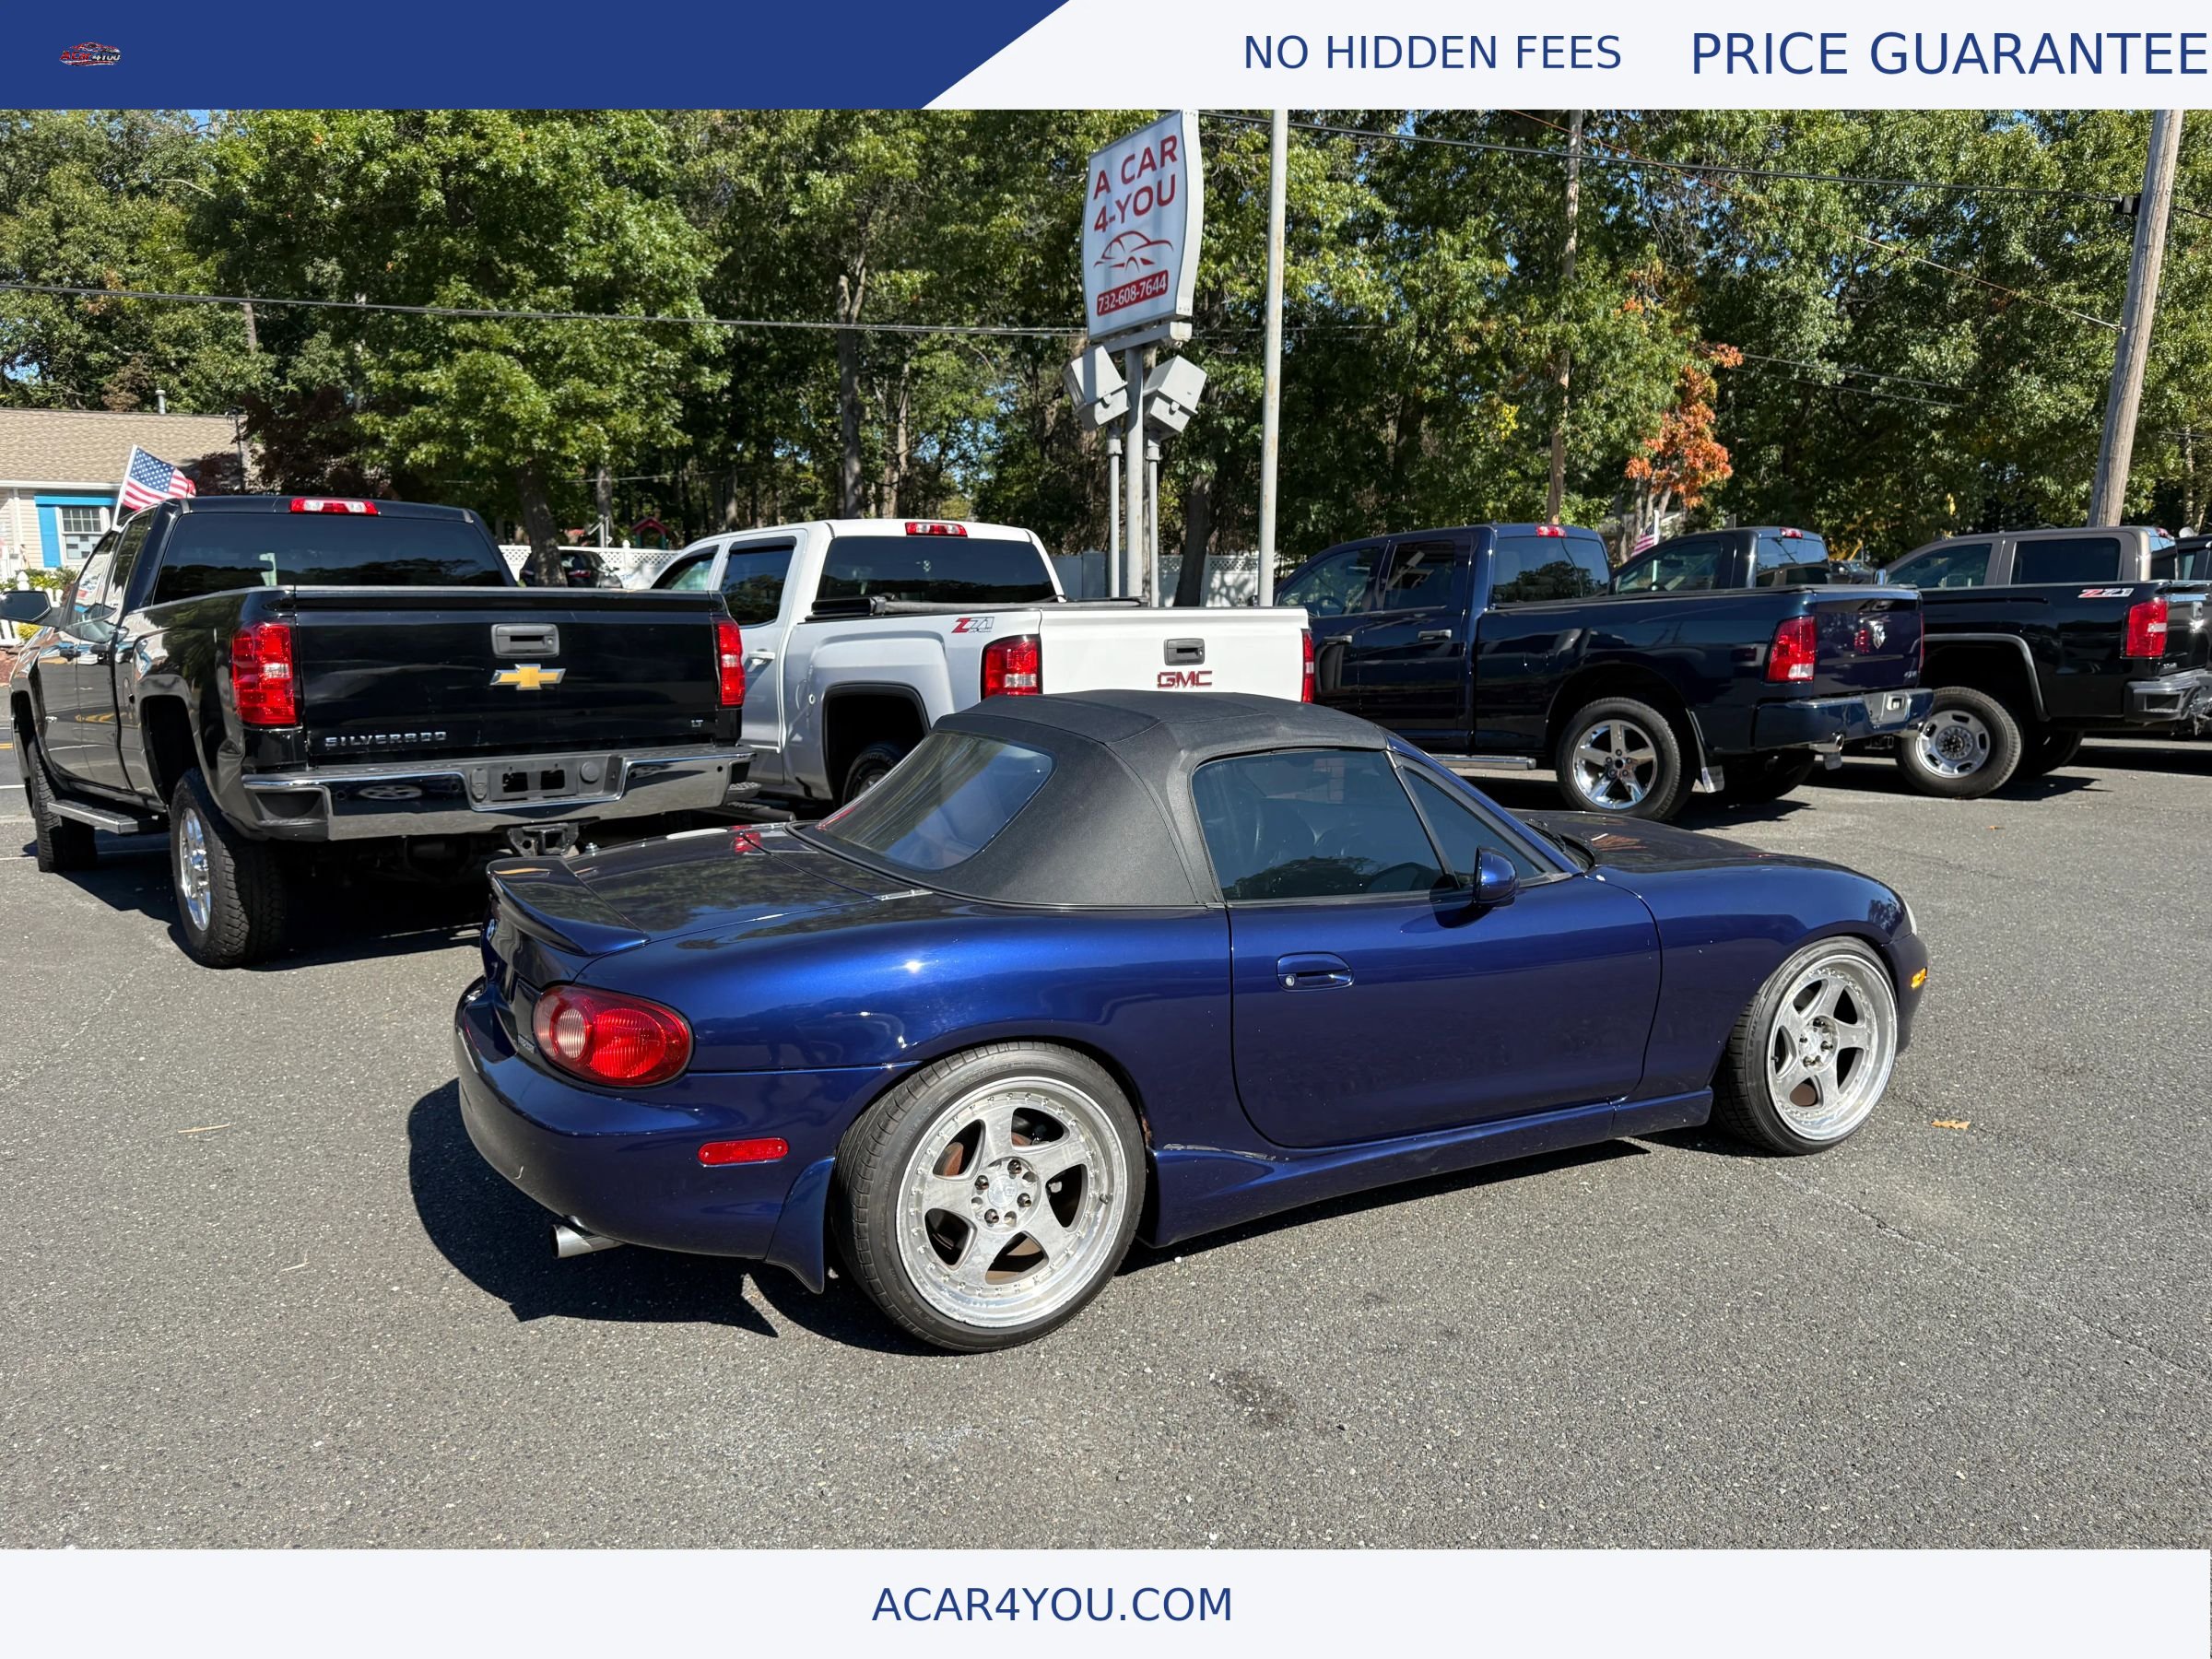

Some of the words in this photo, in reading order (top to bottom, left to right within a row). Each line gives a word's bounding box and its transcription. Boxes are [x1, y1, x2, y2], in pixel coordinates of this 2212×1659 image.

[1093, 170, 1112, 200] A
[1121, 135, 1178, 185] CAR
[1093, 173, 1176, 233] 4-YOU
[1098, 274, 1167, 313] 732-608-7644
[951, 616, 995, 634] Z71
[1158, 670, 1213, 688] GMC
[325, 731, 446, 747] SILVERADO
